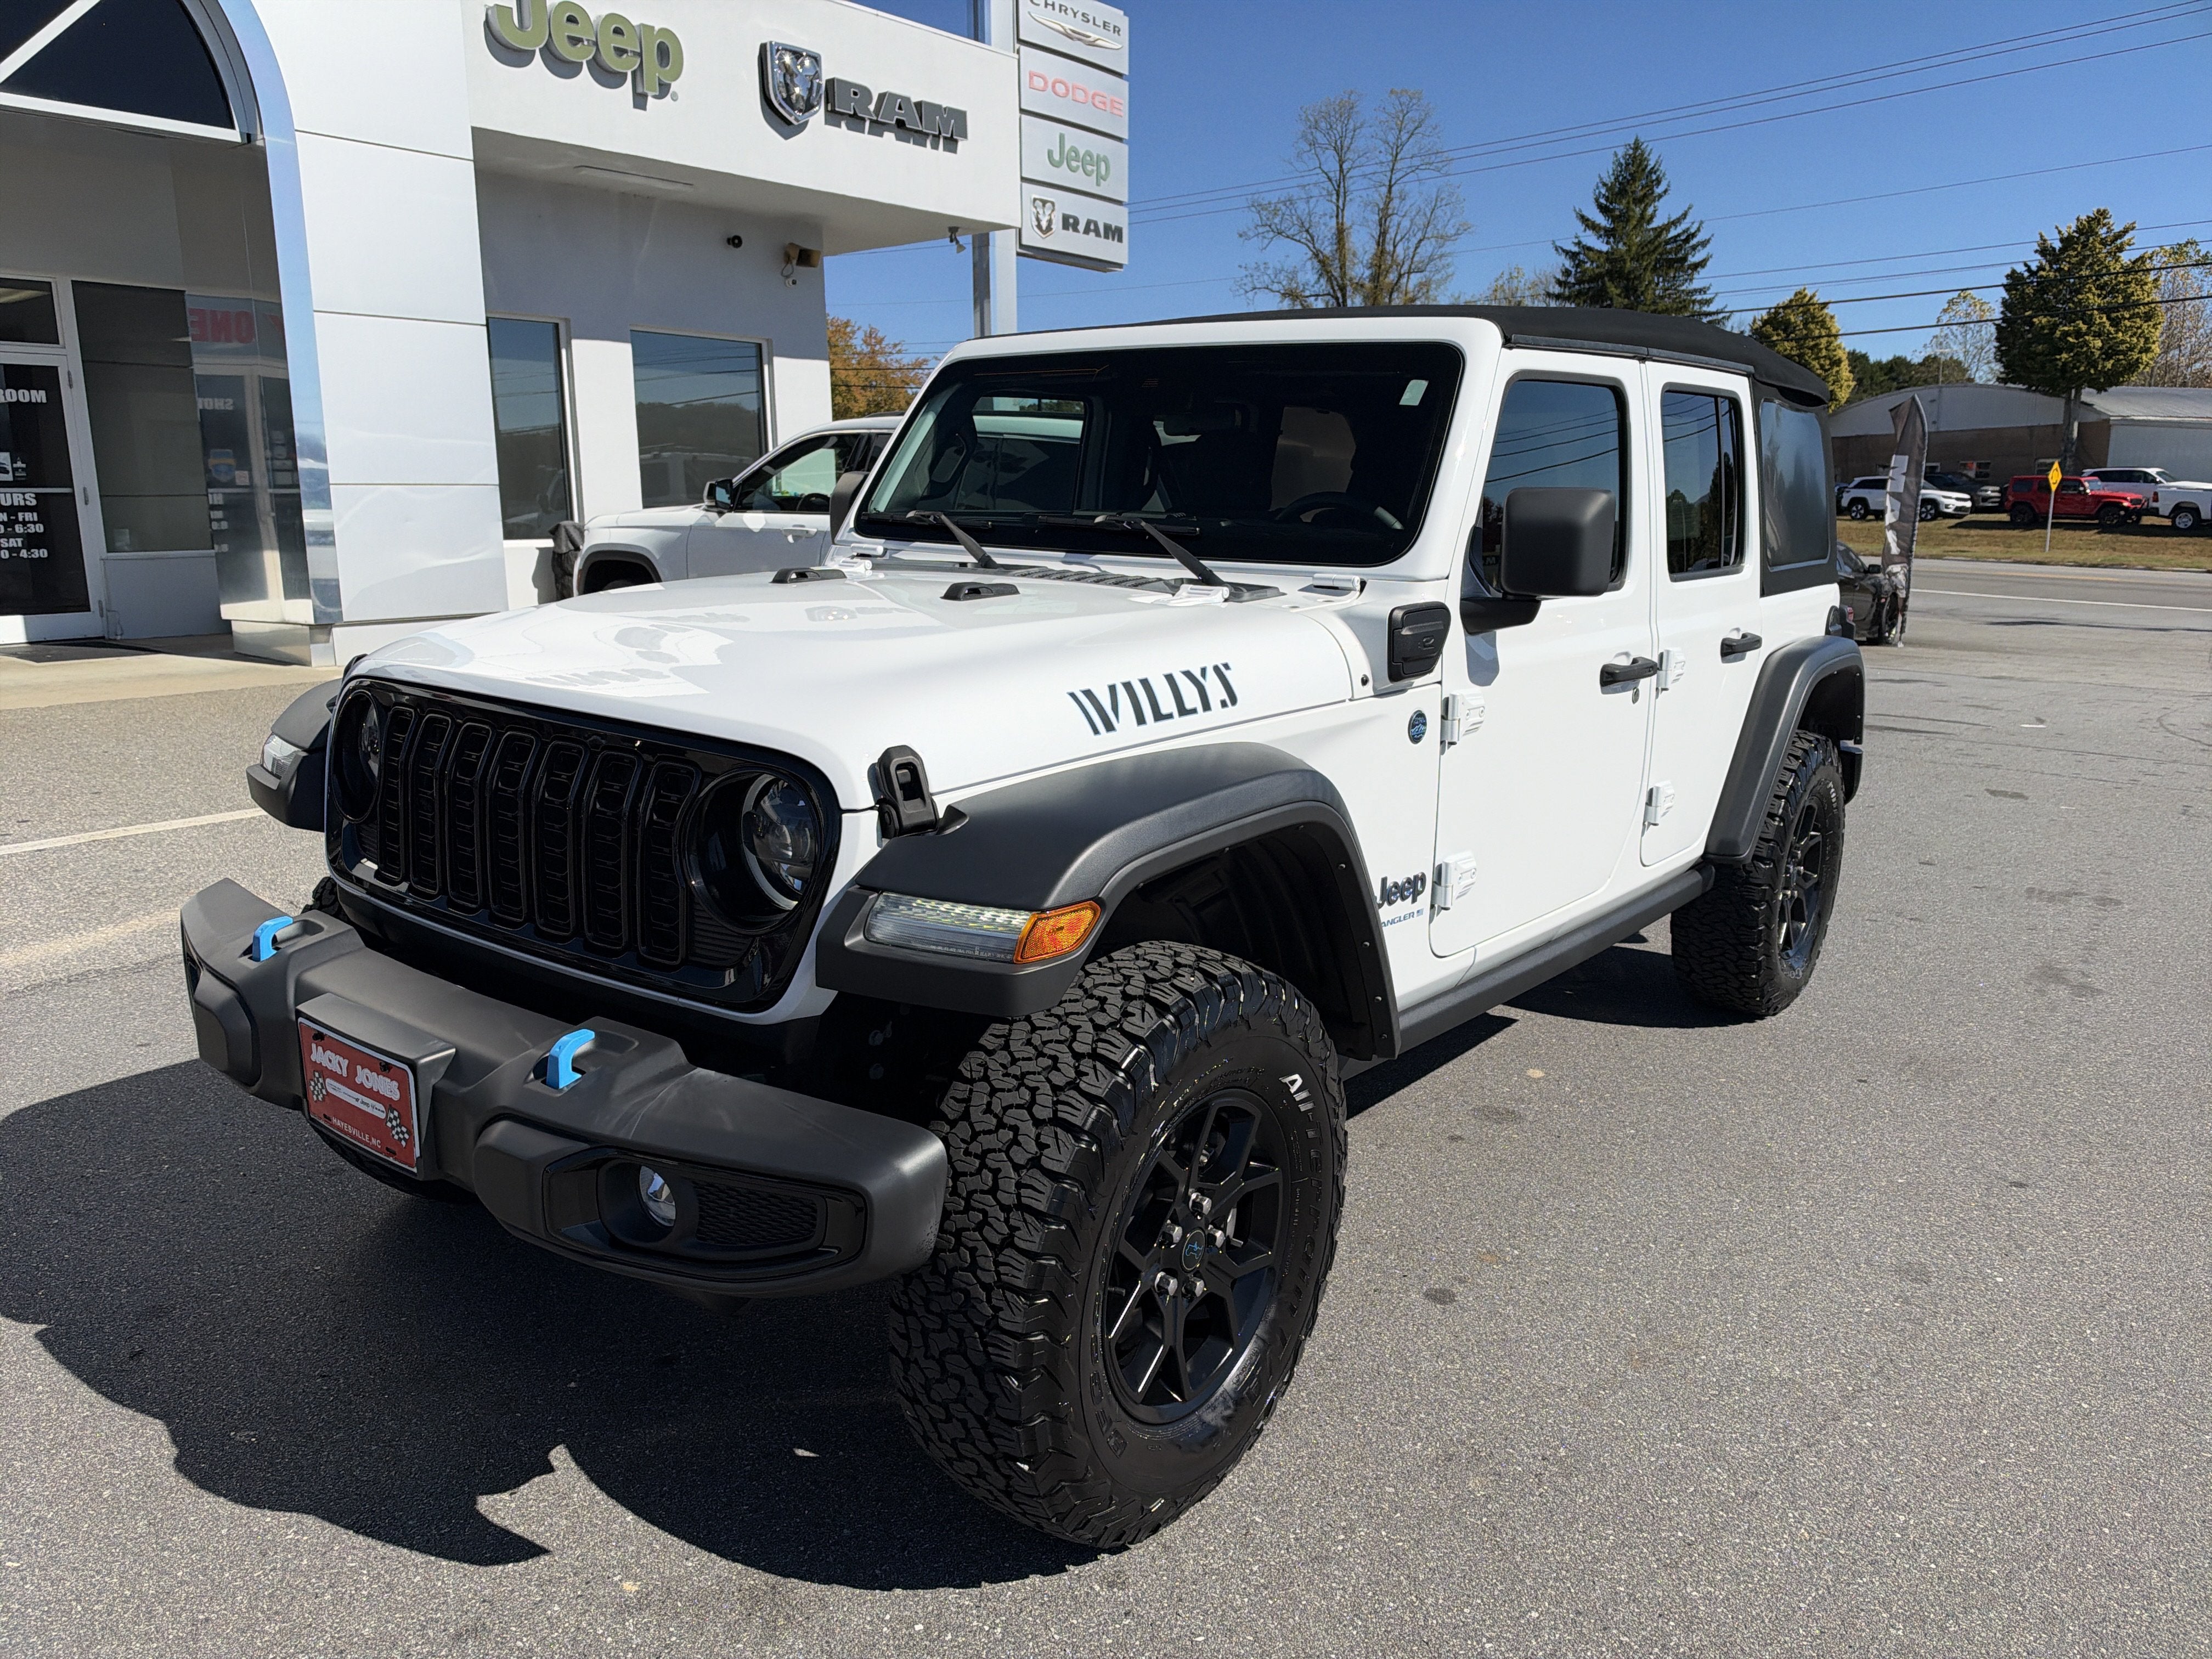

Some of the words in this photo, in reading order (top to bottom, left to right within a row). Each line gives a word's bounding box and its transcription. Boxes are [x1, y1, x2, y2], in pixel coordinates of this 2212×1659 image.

[487, 0, 684, 96] Jeep
[826, 77, 968, 142] RAM
[1029, 70, 1124, 117] DODGE
[1047, 132, 1111, 187] Jeep
[1062, 212, 1124, 243] RAM
[0, 493, 37, 506] URS
[18, 512, 38, 522] FRI
[1, 538, 23, 548] SAT
[15, 523, 44, 533] 6:30
[20, 549, 48, 558] 4:30
[1066, 662, 1238, 736] WILLYS
[1376, 872, 1426, 910] Jeep
[311, 1043, 349, 1077] JACKY
[356, 1065, 400, 1101] JONES
